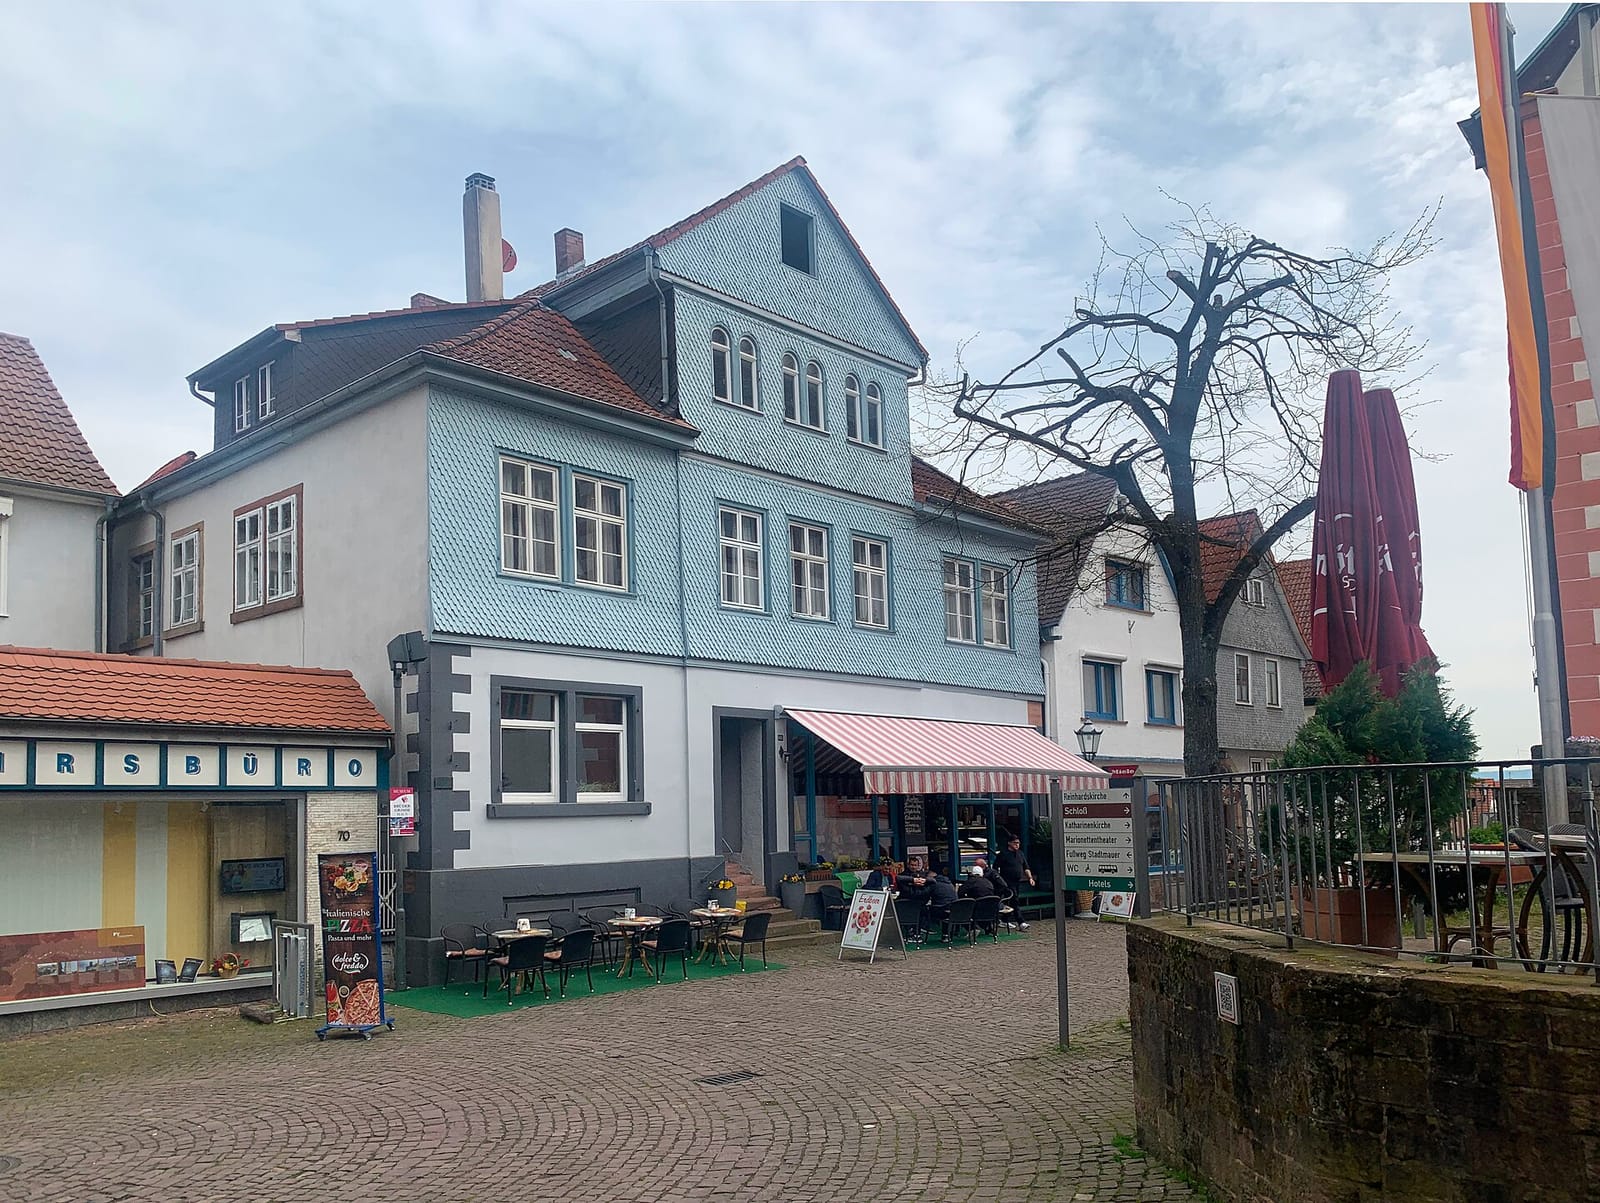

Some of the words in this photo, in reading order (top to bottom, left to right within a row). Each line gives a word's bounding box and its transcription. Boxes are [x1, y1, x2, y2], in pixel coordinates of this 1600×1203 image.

[1064, 806, 1088, 815] Schloß
[1065, 820, 1111, 830] Katharinenkirche
[337, 830, 350, 841] 70
[1065, 834, 1117, 844] Marionettentheater
[1088, 850, 1121, 859] Stadtmauer
[1066, 863, 1079, 873] WC
[1088, 879, 1112, 889] Hotels
[326, 908, 371, 918] Italienische
[327, 919, 372, 933] PIZZA
[328, 934, 343, 942] Pasta
[335, 952, 352, 963] dolce
[352, 952, 361, 963] &
[340, 962, 364, 971] freddo
